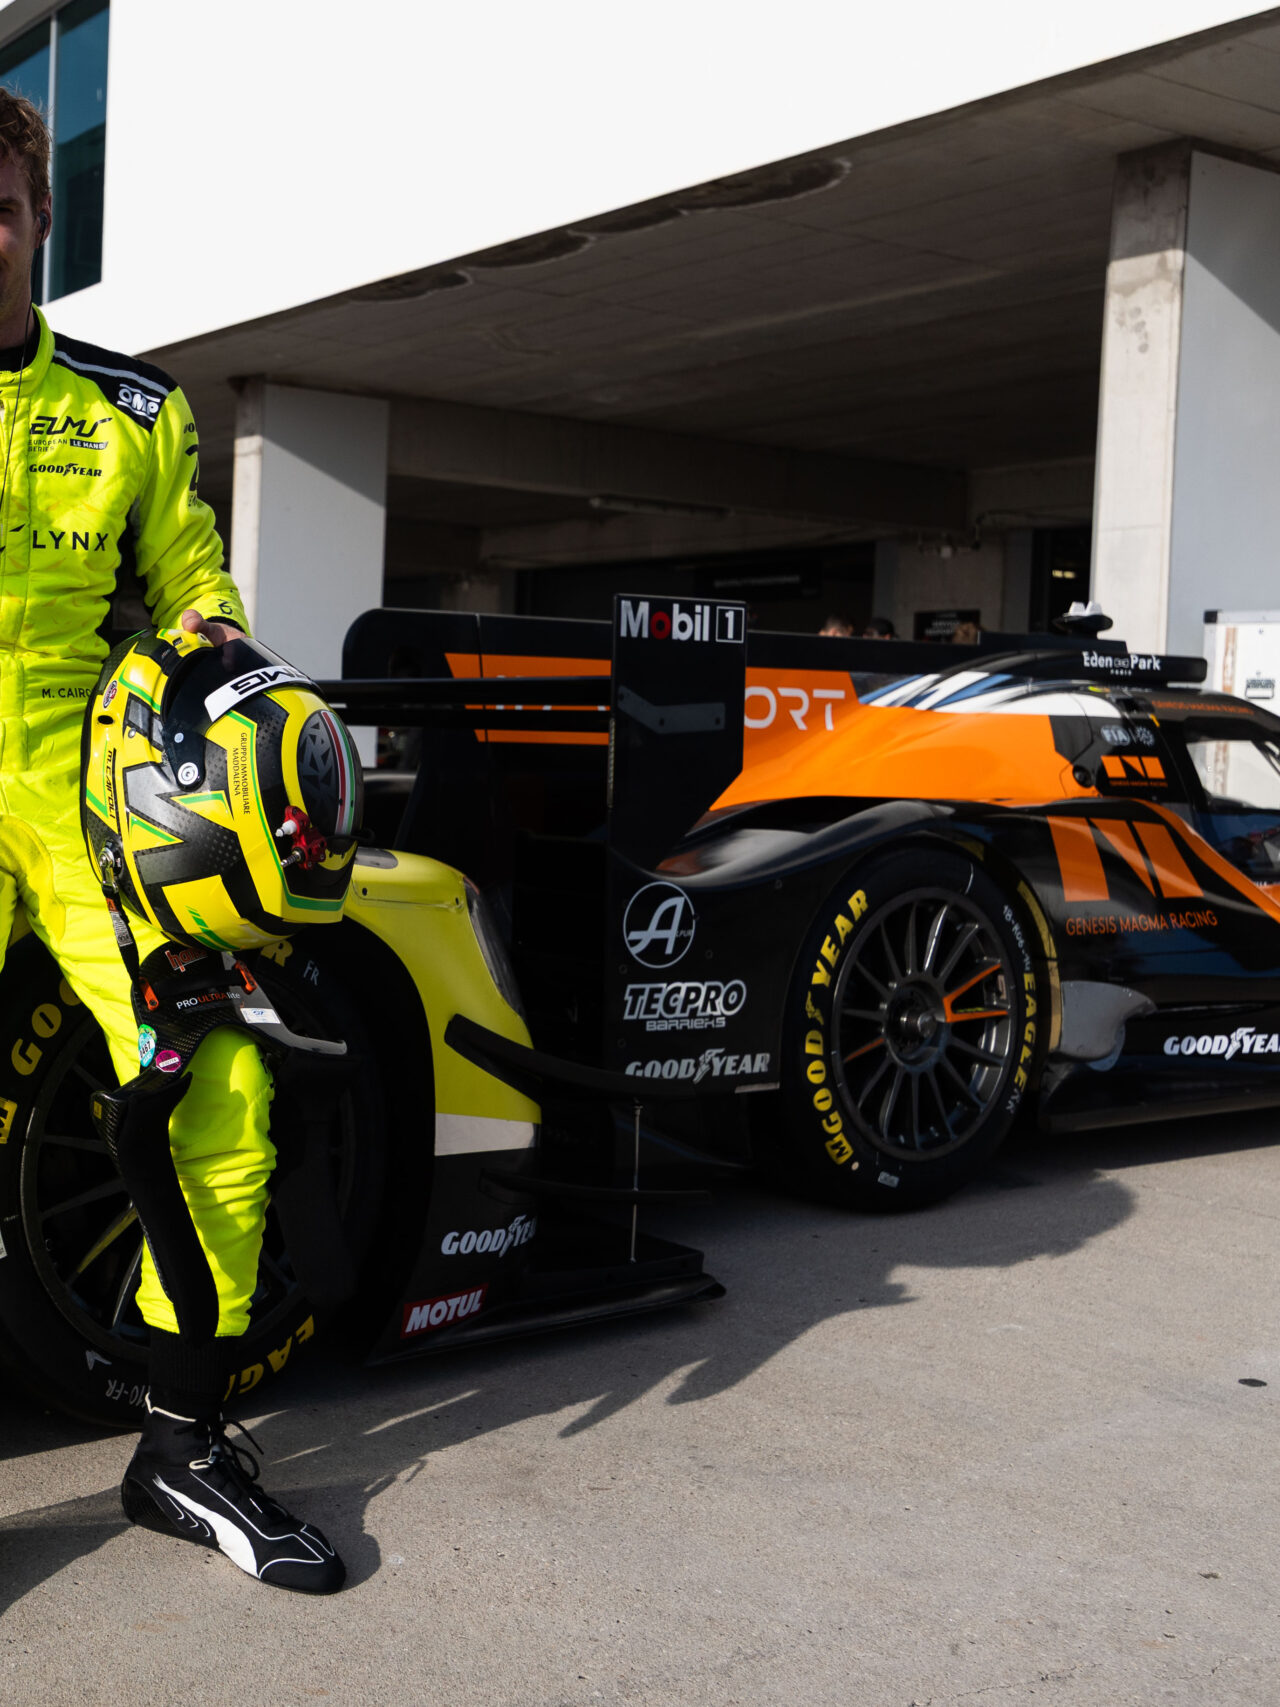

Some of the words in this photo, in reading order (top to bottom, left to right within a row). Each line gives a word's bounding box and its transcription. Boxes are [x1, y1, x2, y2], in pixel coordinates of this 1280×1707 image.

[119, 387, 159, 414] OMP
[32, 531, 109, 551] LYNX
[620, 601, 710, 642] Mobil
[1082, 651, 1113, 667] Eden
[1129, 654, 1161, 671] Park
[58, 688, 92, 698] CAIRO
[1066, 916, 1117, 936] GENESIS
[1120, 913, 1170, 932] MAGMA
[1172, 910, 1218, 929] RACING
[623, 979, 747, 1021] TECPRO
[1163, 1027, 1280, 1060] GOODYEA
[625, 1047, 770, 1085] GOODYEAR
[441, 1214, 537, 1258] GOODYEA
[405, 1290, 482, 1333] MOTUL
